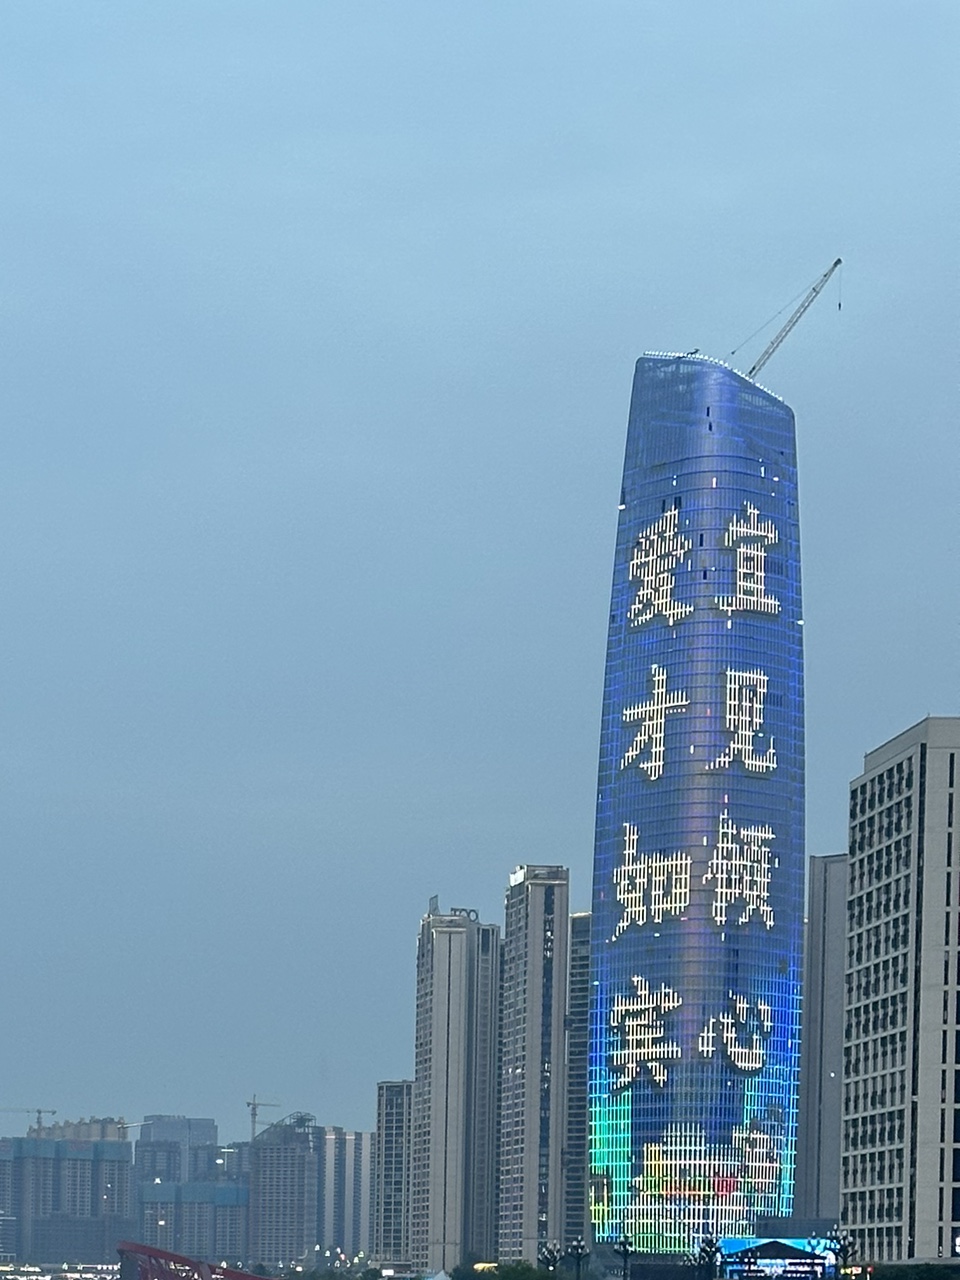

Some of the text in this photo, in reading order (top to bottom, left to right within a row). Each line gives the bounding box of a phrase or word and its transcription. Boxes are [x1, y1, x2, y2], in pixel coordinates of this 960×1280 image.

[605, 504, 694, 1090] 爱才如宾
[699, 500, 782, 1071] 宜见倾心
